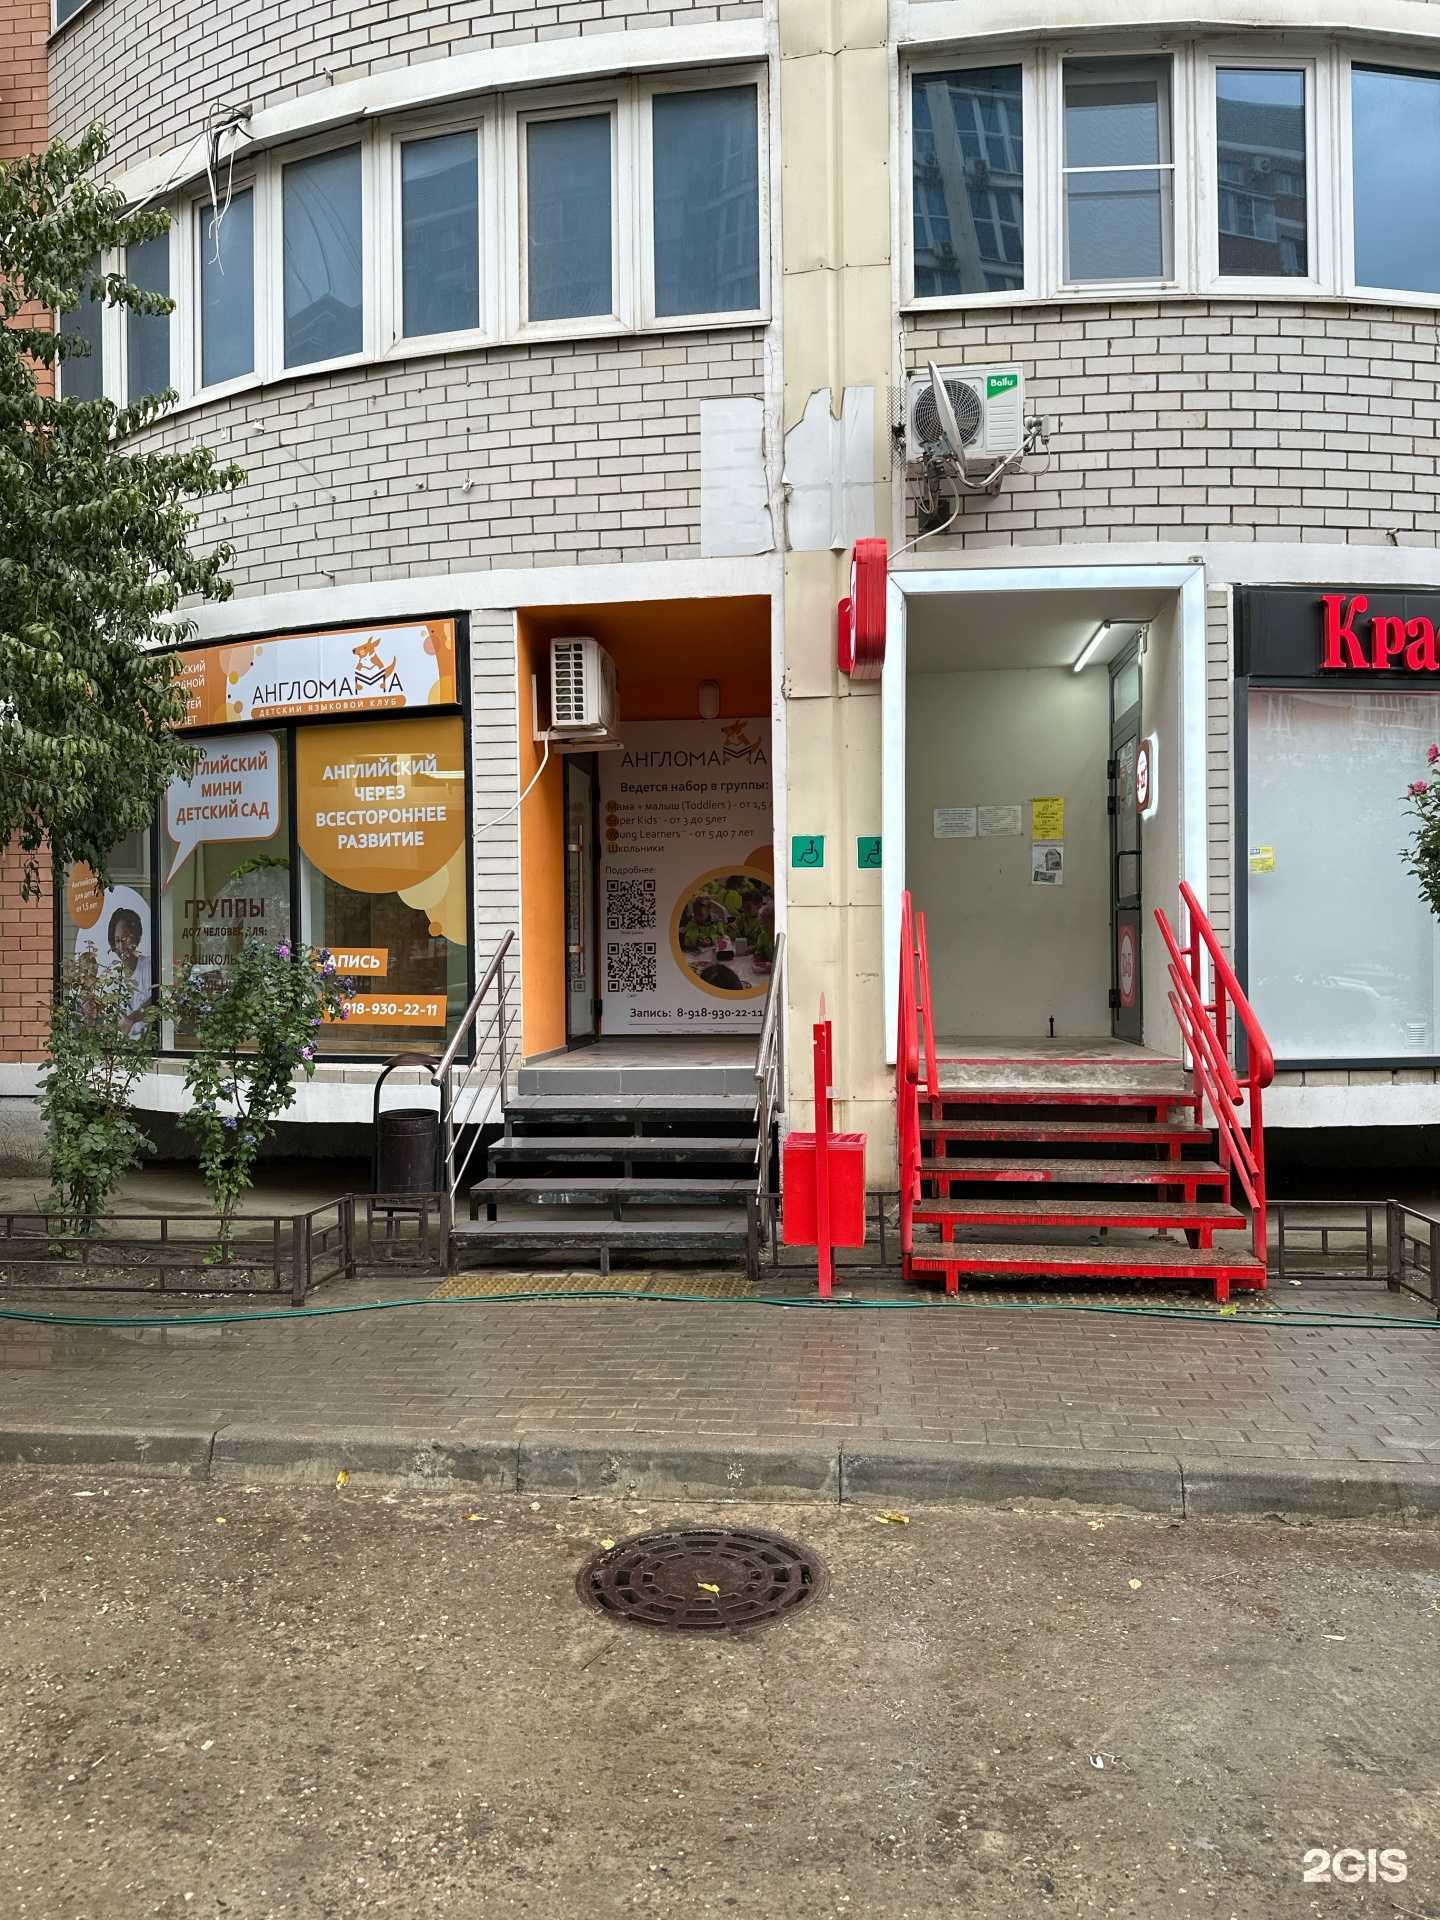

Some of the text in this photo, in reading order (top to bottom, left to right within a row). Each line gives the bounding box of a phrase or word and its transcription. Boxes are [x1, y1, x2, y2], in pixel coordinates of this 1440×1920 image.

[991, 377, 1013, 387] Ballu
[1321, 594, 1440, 671] Кра
[252, 670, 404, 705] АНГЛОМАМА
[259, 698, 397, 717] ДЕТСКИЙ ЯЗЫКОВОЙ КЛУБ
[193, 751, 268, 776] ГЛИЙСКИЙ
[621, 746, 768, 768] АНГЛОМАМА
[322, 753, 437, 780] АНГЛИЙСКИЙ
[201, 781, 242, 797] МИНИ
[354, 785, 406, 801] ЧЕРЕЗ
[620, 780, 769, 793] Ведется набор в группы:
[176, 799, 270, 825] ДЕТСКИЙ САД
[645, 803, 680, 811] малыш
[315, 806, 447, 827] ВСЕСТОРОННЕЕ
[338, 831, 425, 849] РАЗВИТИЕ
[715, 830, 728, 839] до
[184, 898, 265, 919] ГРУППЫ
[182, 927, 195, 939] ДО
[318, 954, 381, 969] АПИСЬ
[629, 1008, 763, 1020] Запись: 8-918-930-22-11
